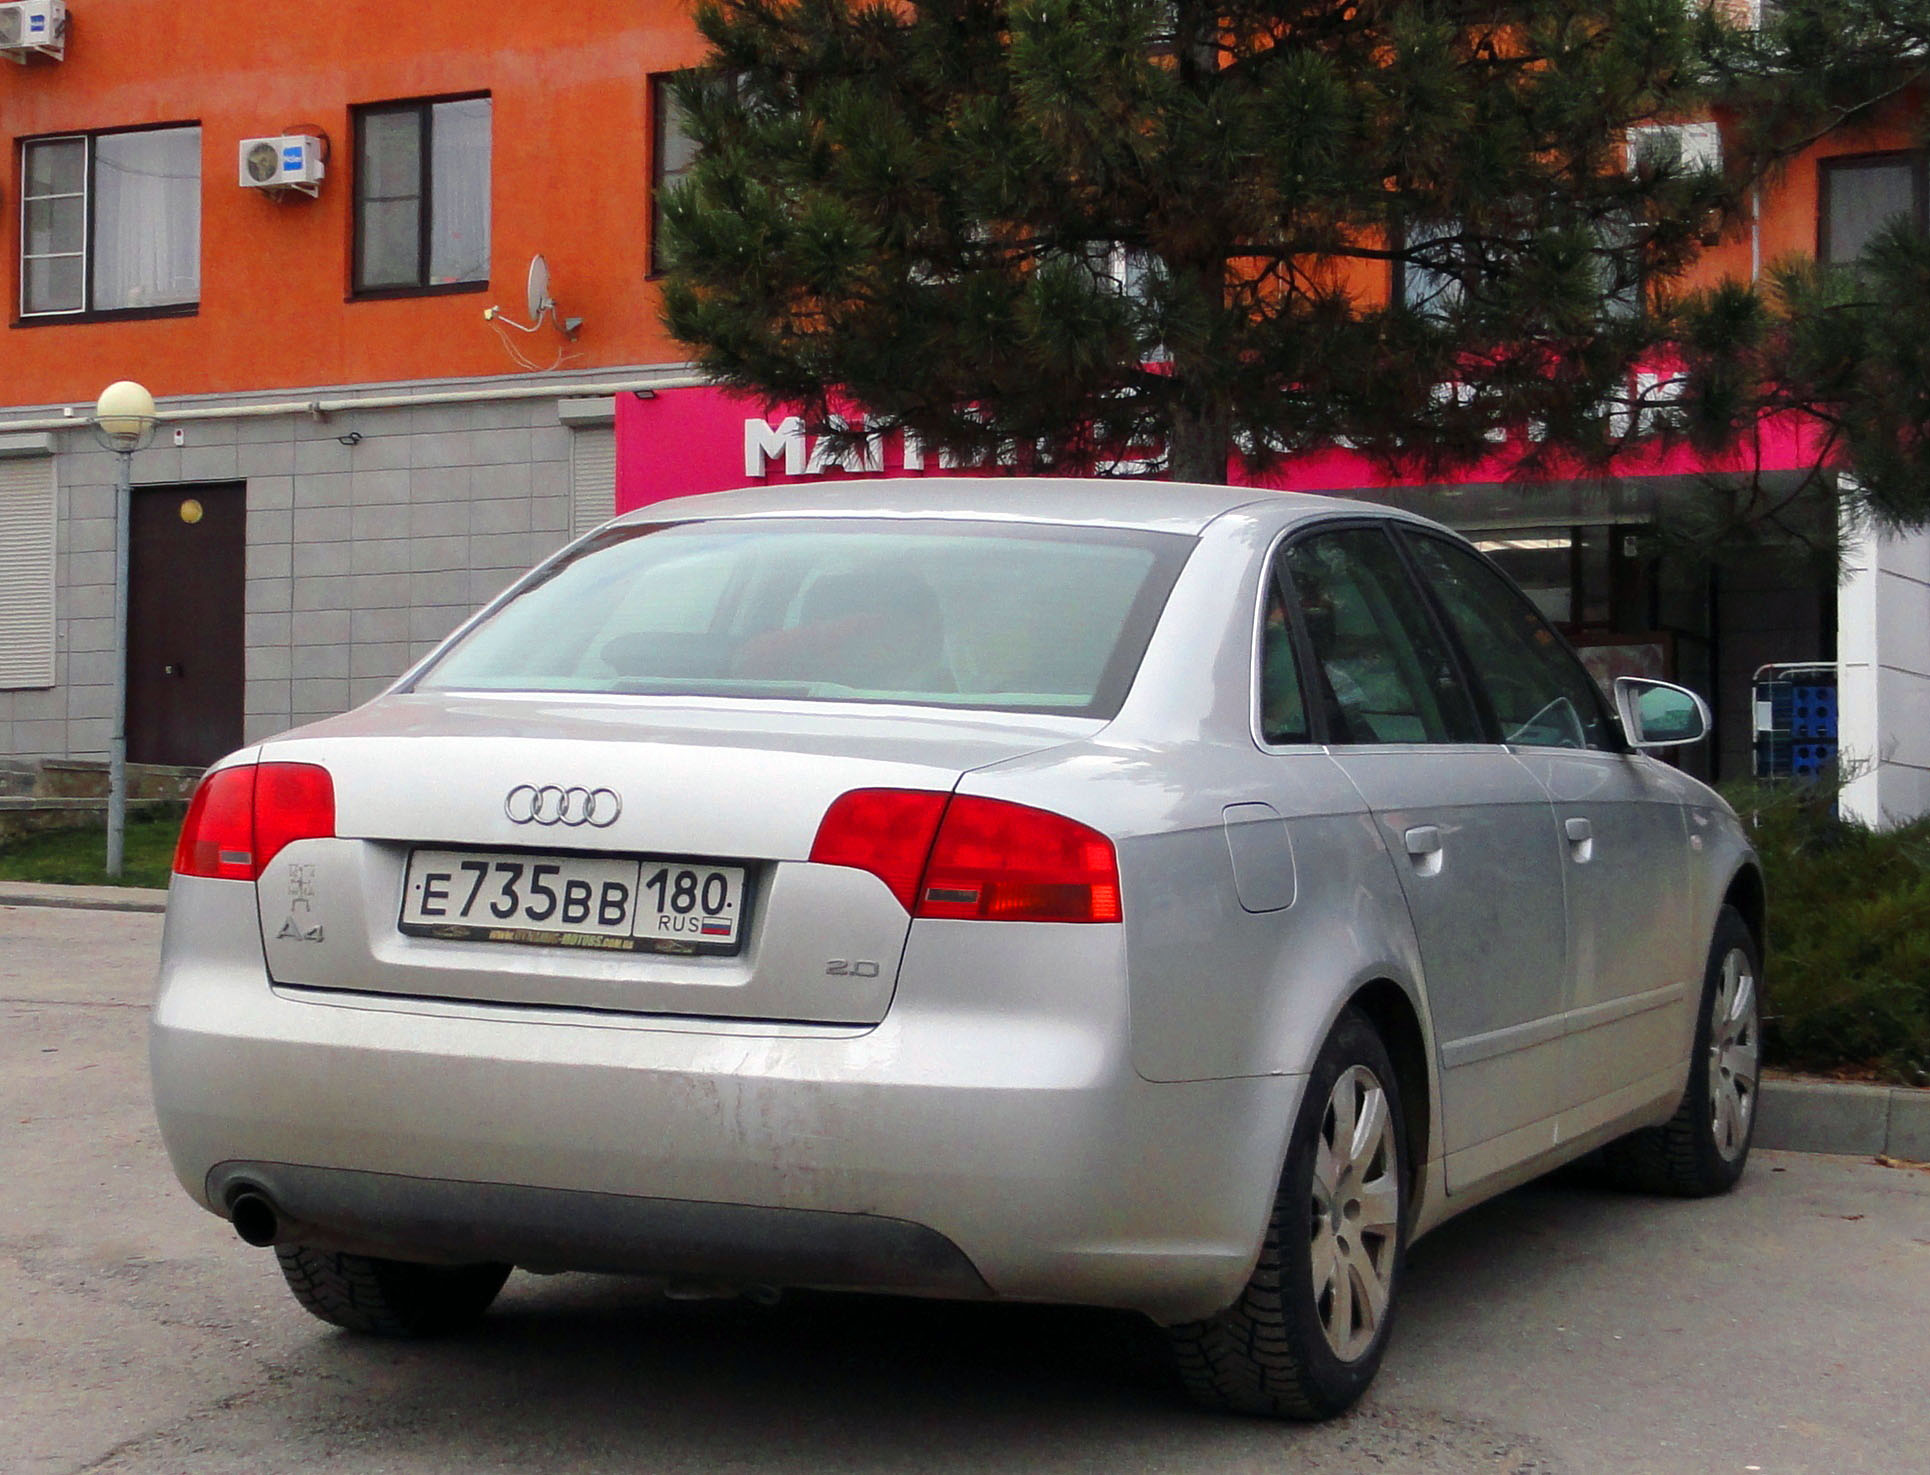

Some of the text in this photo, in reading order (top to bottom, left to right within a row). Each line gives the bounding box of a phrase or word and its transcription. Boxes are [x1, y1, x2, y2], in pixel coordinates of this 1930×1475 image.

[645, 868, 728, 915] 180
[276, 915, 325, 943] A4
[657, 915, 700, 933] RUS
[825, 958, 880, 978] 2.0
